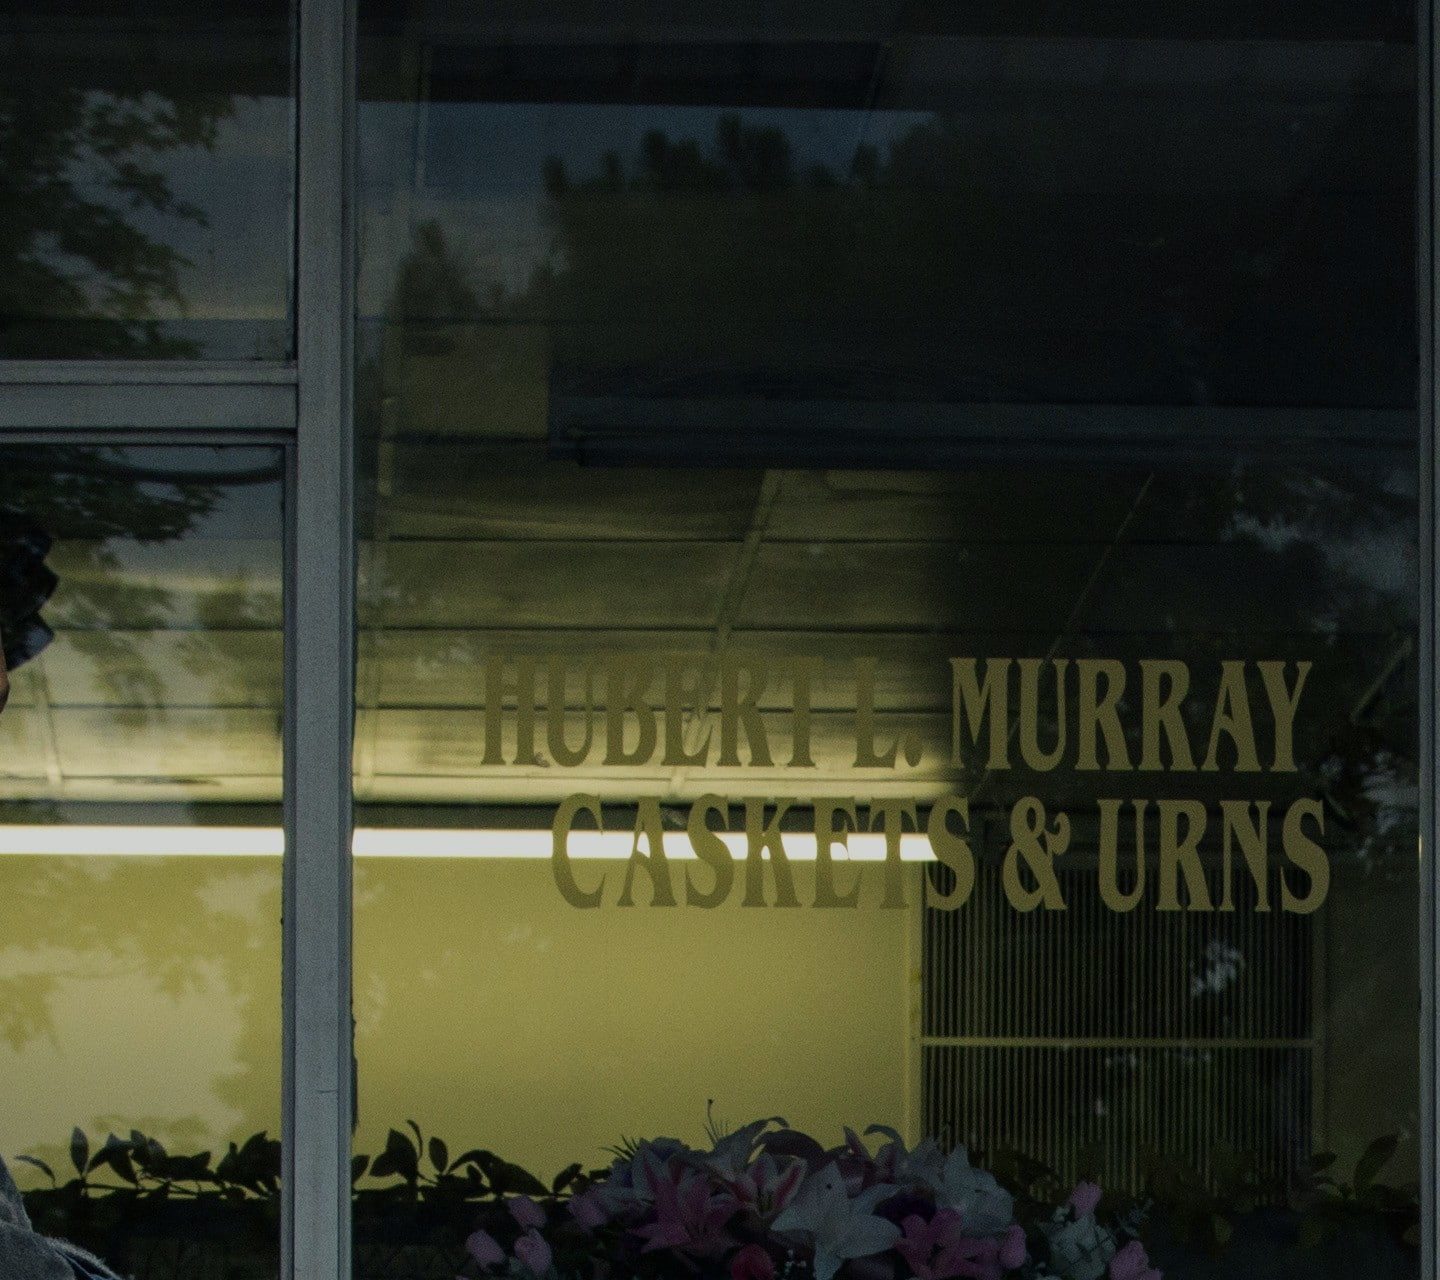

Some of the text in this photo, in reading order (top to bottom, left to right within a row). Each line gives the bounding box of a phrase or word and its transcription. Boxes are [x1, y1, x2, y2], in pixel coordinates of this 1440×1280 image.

[481, 654, 1314, 774] HUBERT L. MURRAY
[550, 792, 1332, 916] CASKETS & URNS
